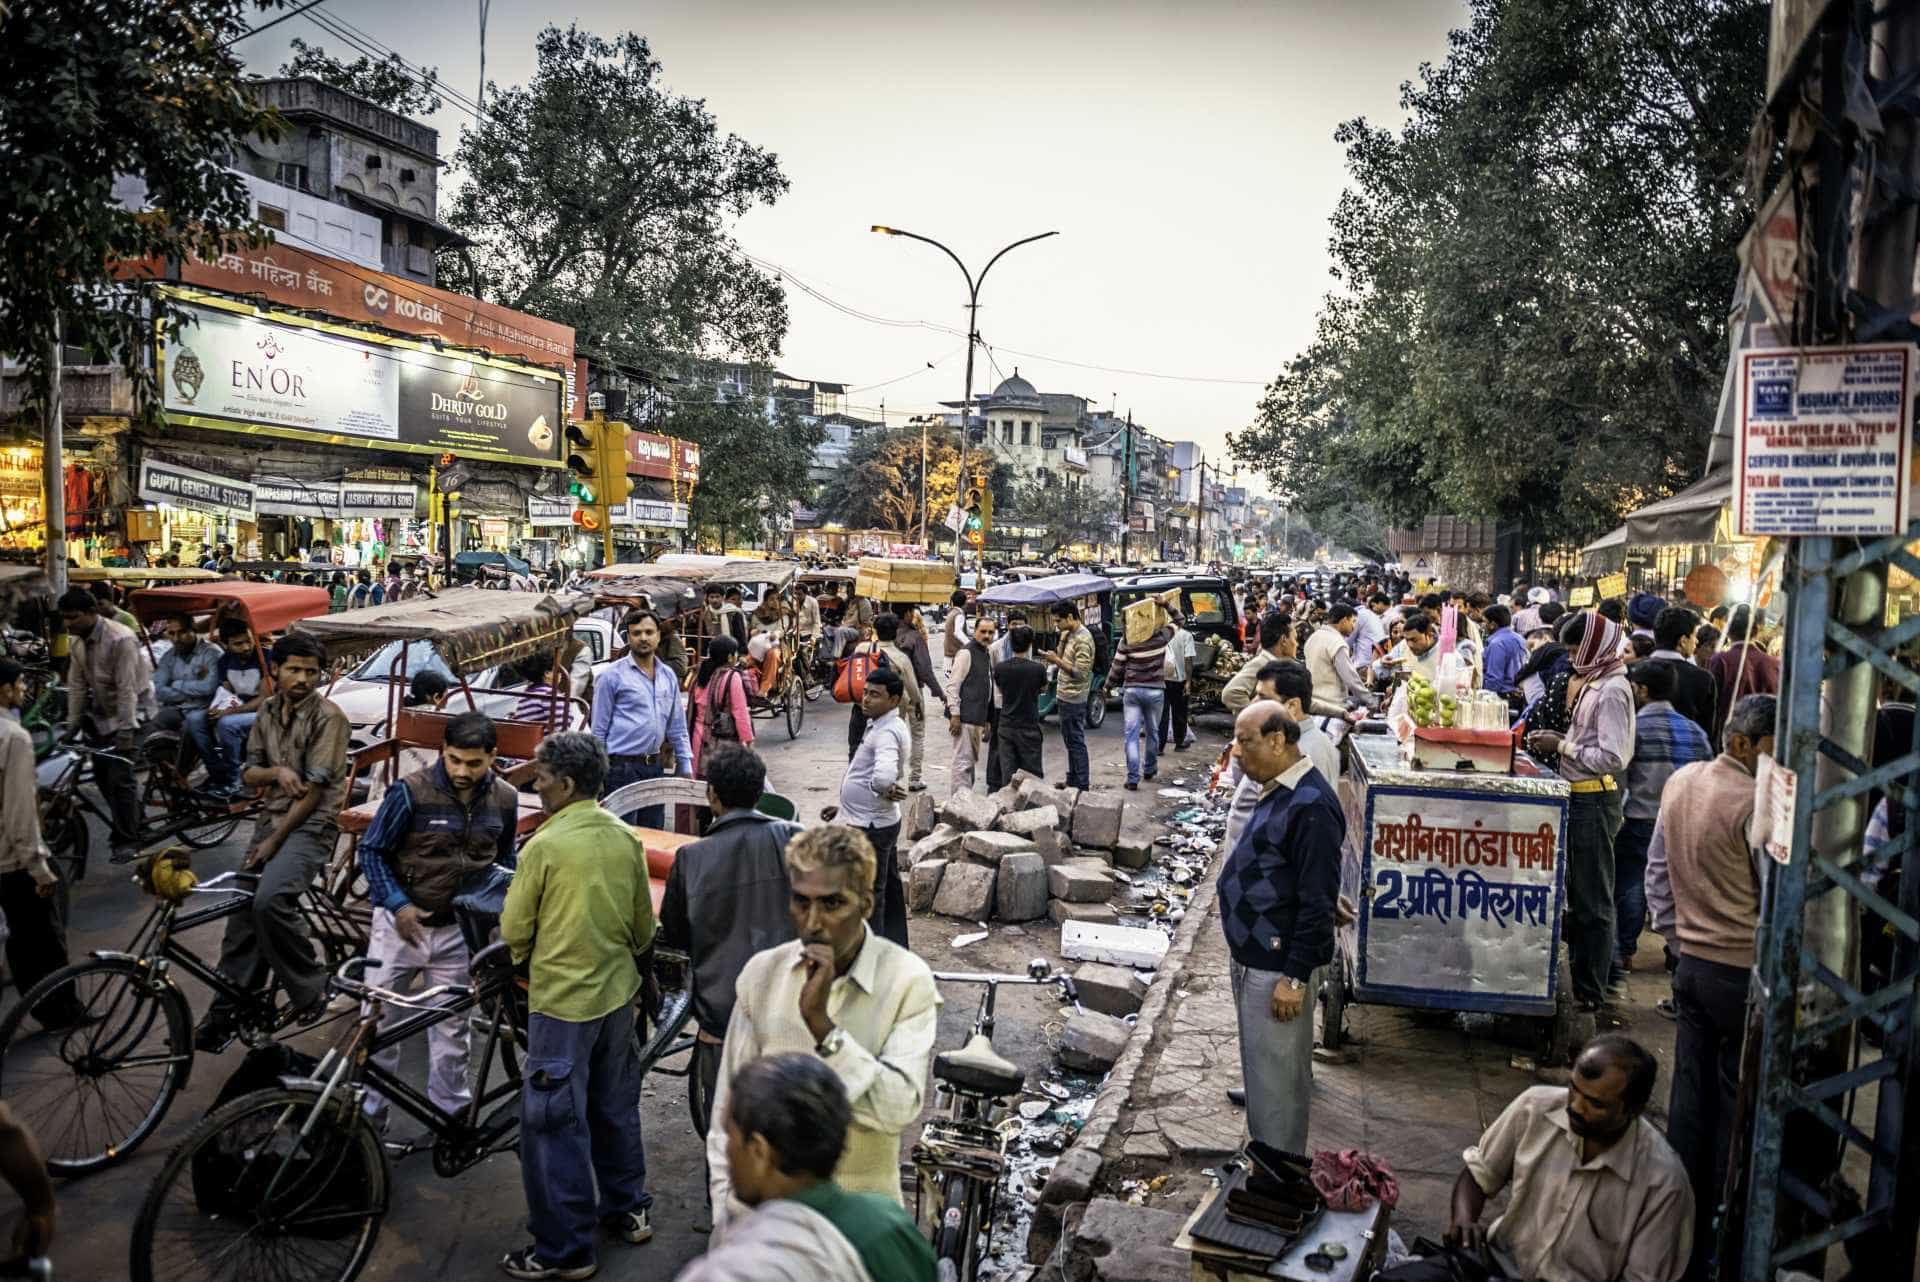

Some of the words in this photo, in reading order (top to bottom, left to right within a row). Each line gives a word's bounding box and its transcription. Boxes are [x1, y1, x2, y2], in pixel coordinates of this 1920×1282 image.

[306, 269, 333, 297] बैंक
[394, 294, 444, 325] kotak
[464, 311, 496, 338] Kotak
[498, 324, 545, 351] Mahindra
[547, 338, 570, 357] Bank
[231, 360, 308, 399] EN'OR
[1759, 385, 1789, 394] TATA
[431, 392, 474, 417] DHRUV
[475, 403, 508, 421] GOLD
[1798, 391, 1849, 408] INSURANCE
[1853, 390, 1900, 406] ADVISORS
[1766, 436, 1803, 447] GENERAL
[1748, 454, 1789, 468] CERTIFIED
[1791, 454, 1838, 467] INSURANCE
[150, 472, 179, 492] GUPTA
[181, 479, 221, 501] GENERAL
[222, 488, 249, 507] STORE
[1747, 475, 1765, 488] TATA
[397, 494, 414, 507] SONS
[1455, 868, 1551, 929] गिलास
